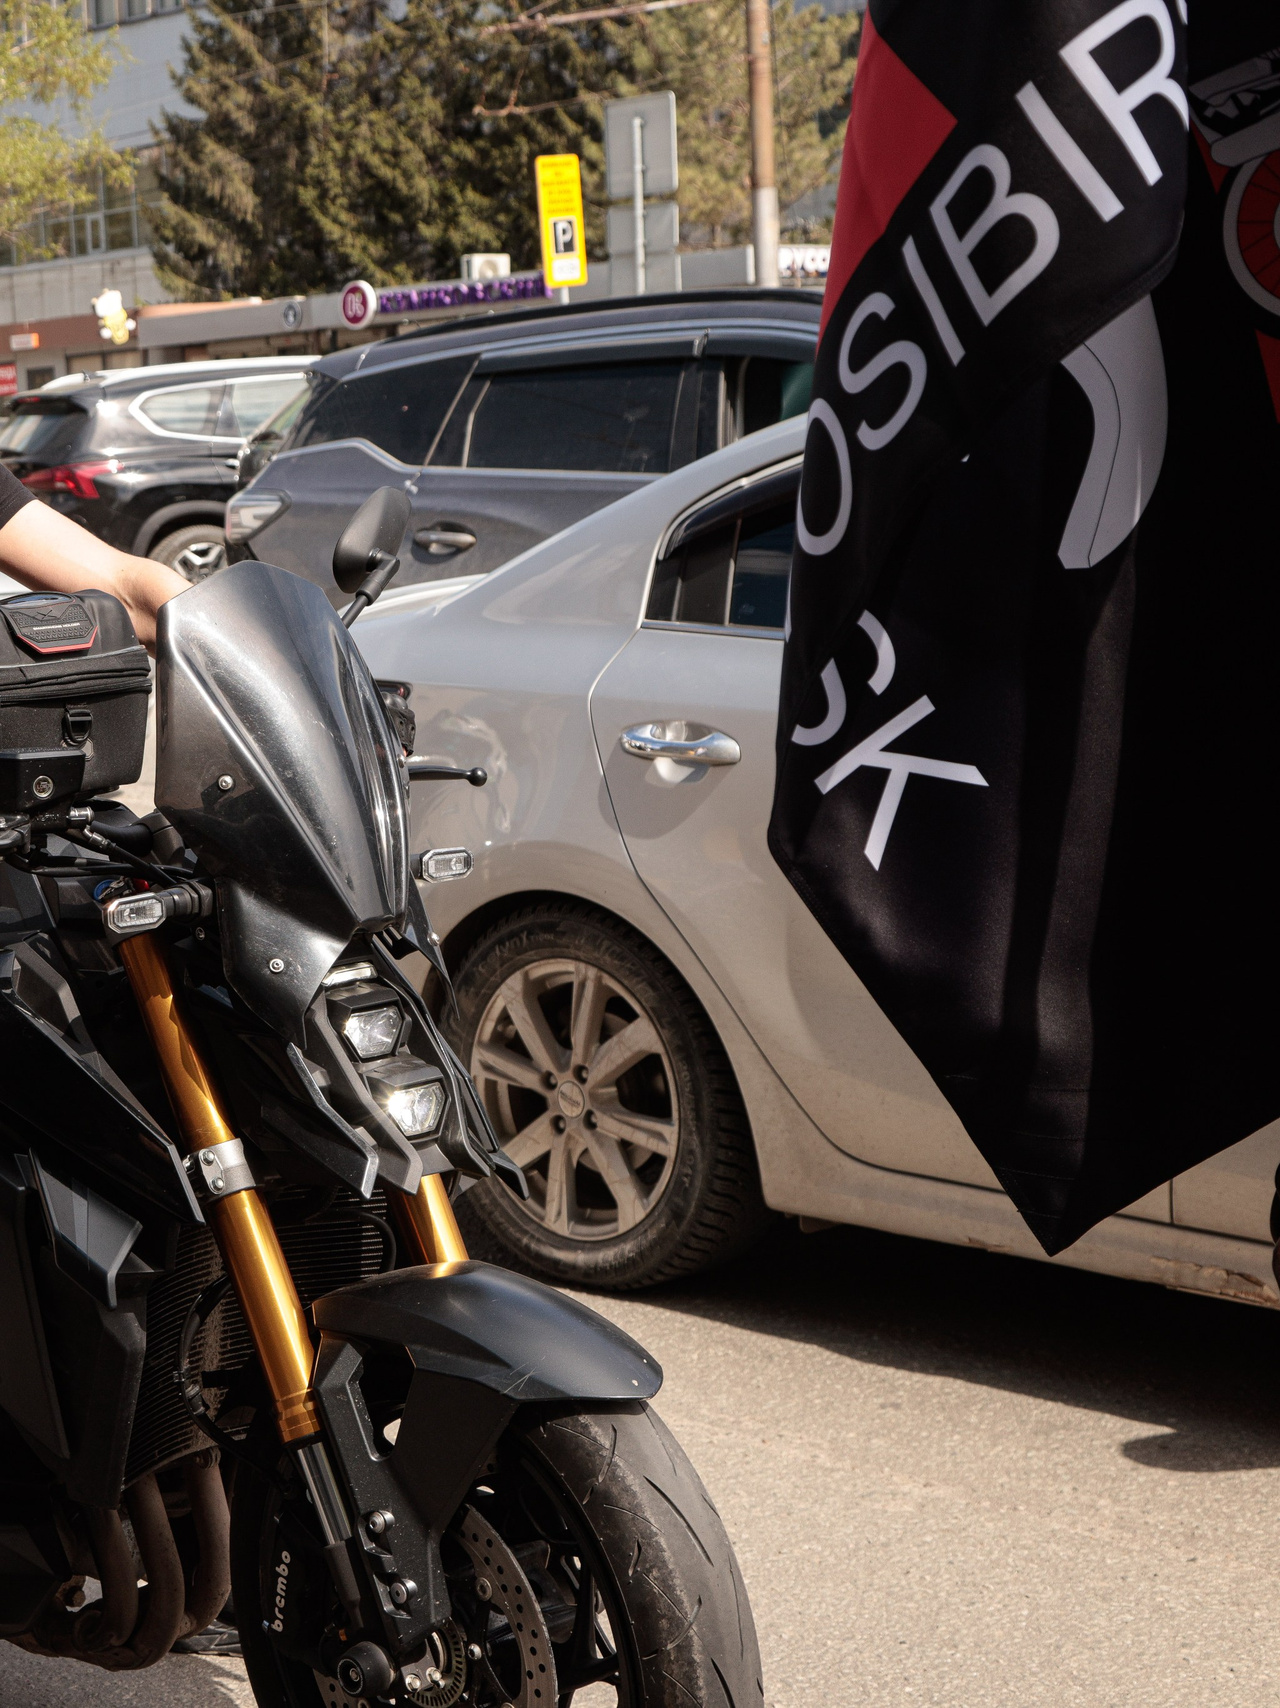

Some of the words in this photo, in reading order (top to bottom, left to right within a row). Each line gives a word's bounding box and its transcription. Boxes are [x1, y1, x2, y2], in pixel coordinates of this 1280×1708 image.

[555, 221, 573, 254] P
[795, 0, 1189, 557] OSIBIR
[270, 1550, 291, 1633] brembo
